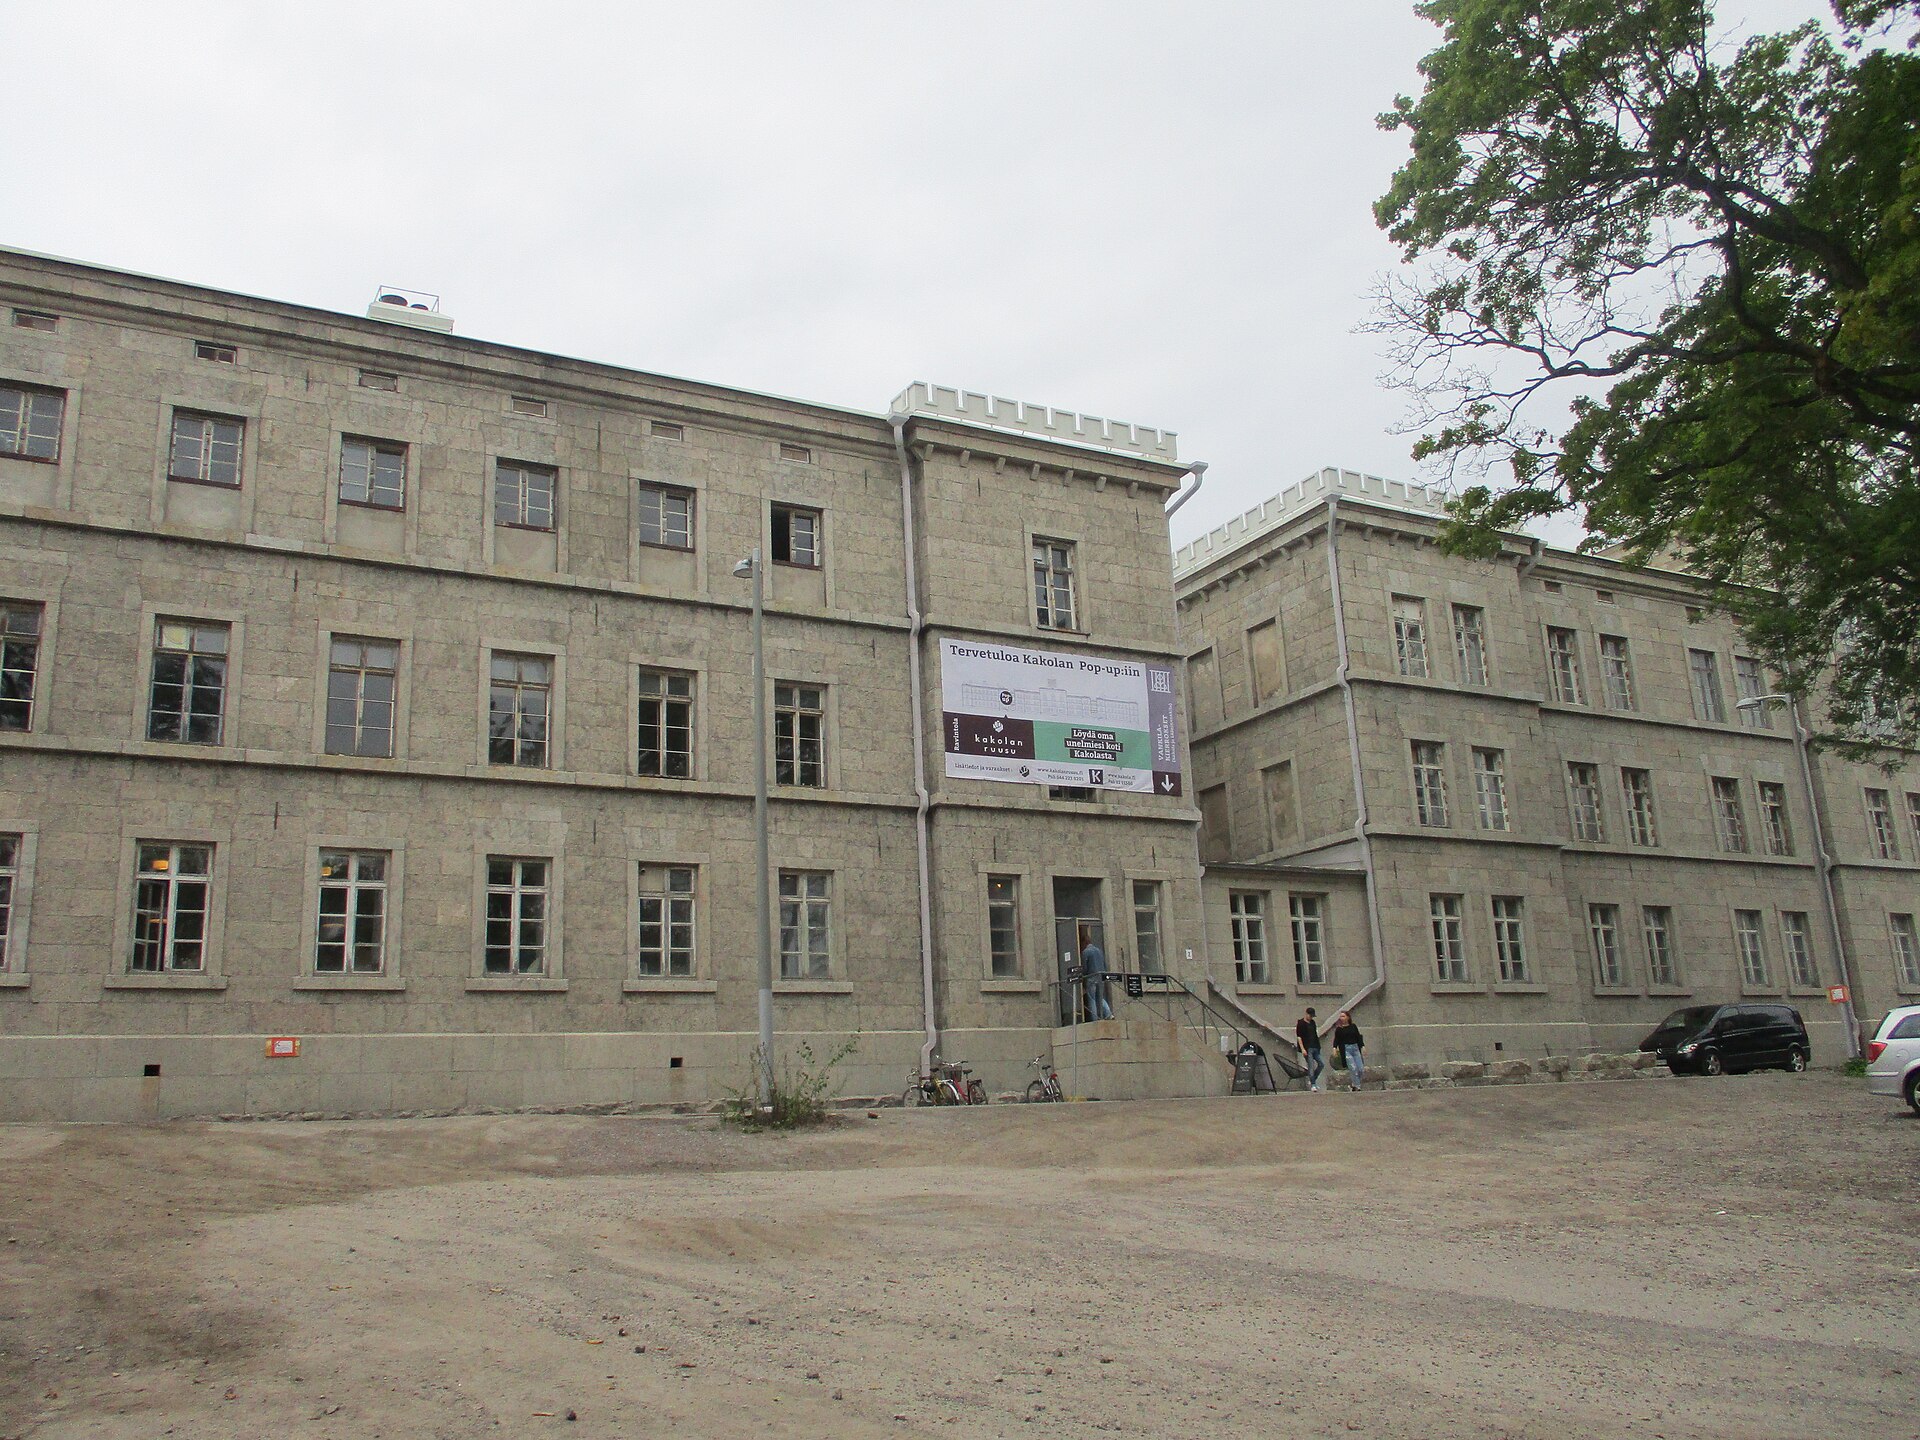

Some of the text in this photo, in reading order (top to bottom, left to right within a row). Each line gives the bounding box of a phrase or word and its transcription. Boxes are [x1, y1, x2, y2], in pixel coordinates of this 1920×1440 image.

[949, 644, 1141, 677] Tervetuloa Kakolan Pop-up:iin
[952, 717, 960, 751] Ravintola
[974, 733, 1023, 747] kakolan
[1073, 729, 1096, 740] Löydä
[1162, 714, 1170, 762] KIERROKSET
[1066, 740, 1121, 751] unelmiesi koti
[1156, 724, 1164, 761] VANKILA-
[983, 746, 1016, 755] ruusu
[1074, 750, 1115, 760] Kakolasta.
[1091, 769, 1101, 783] K
